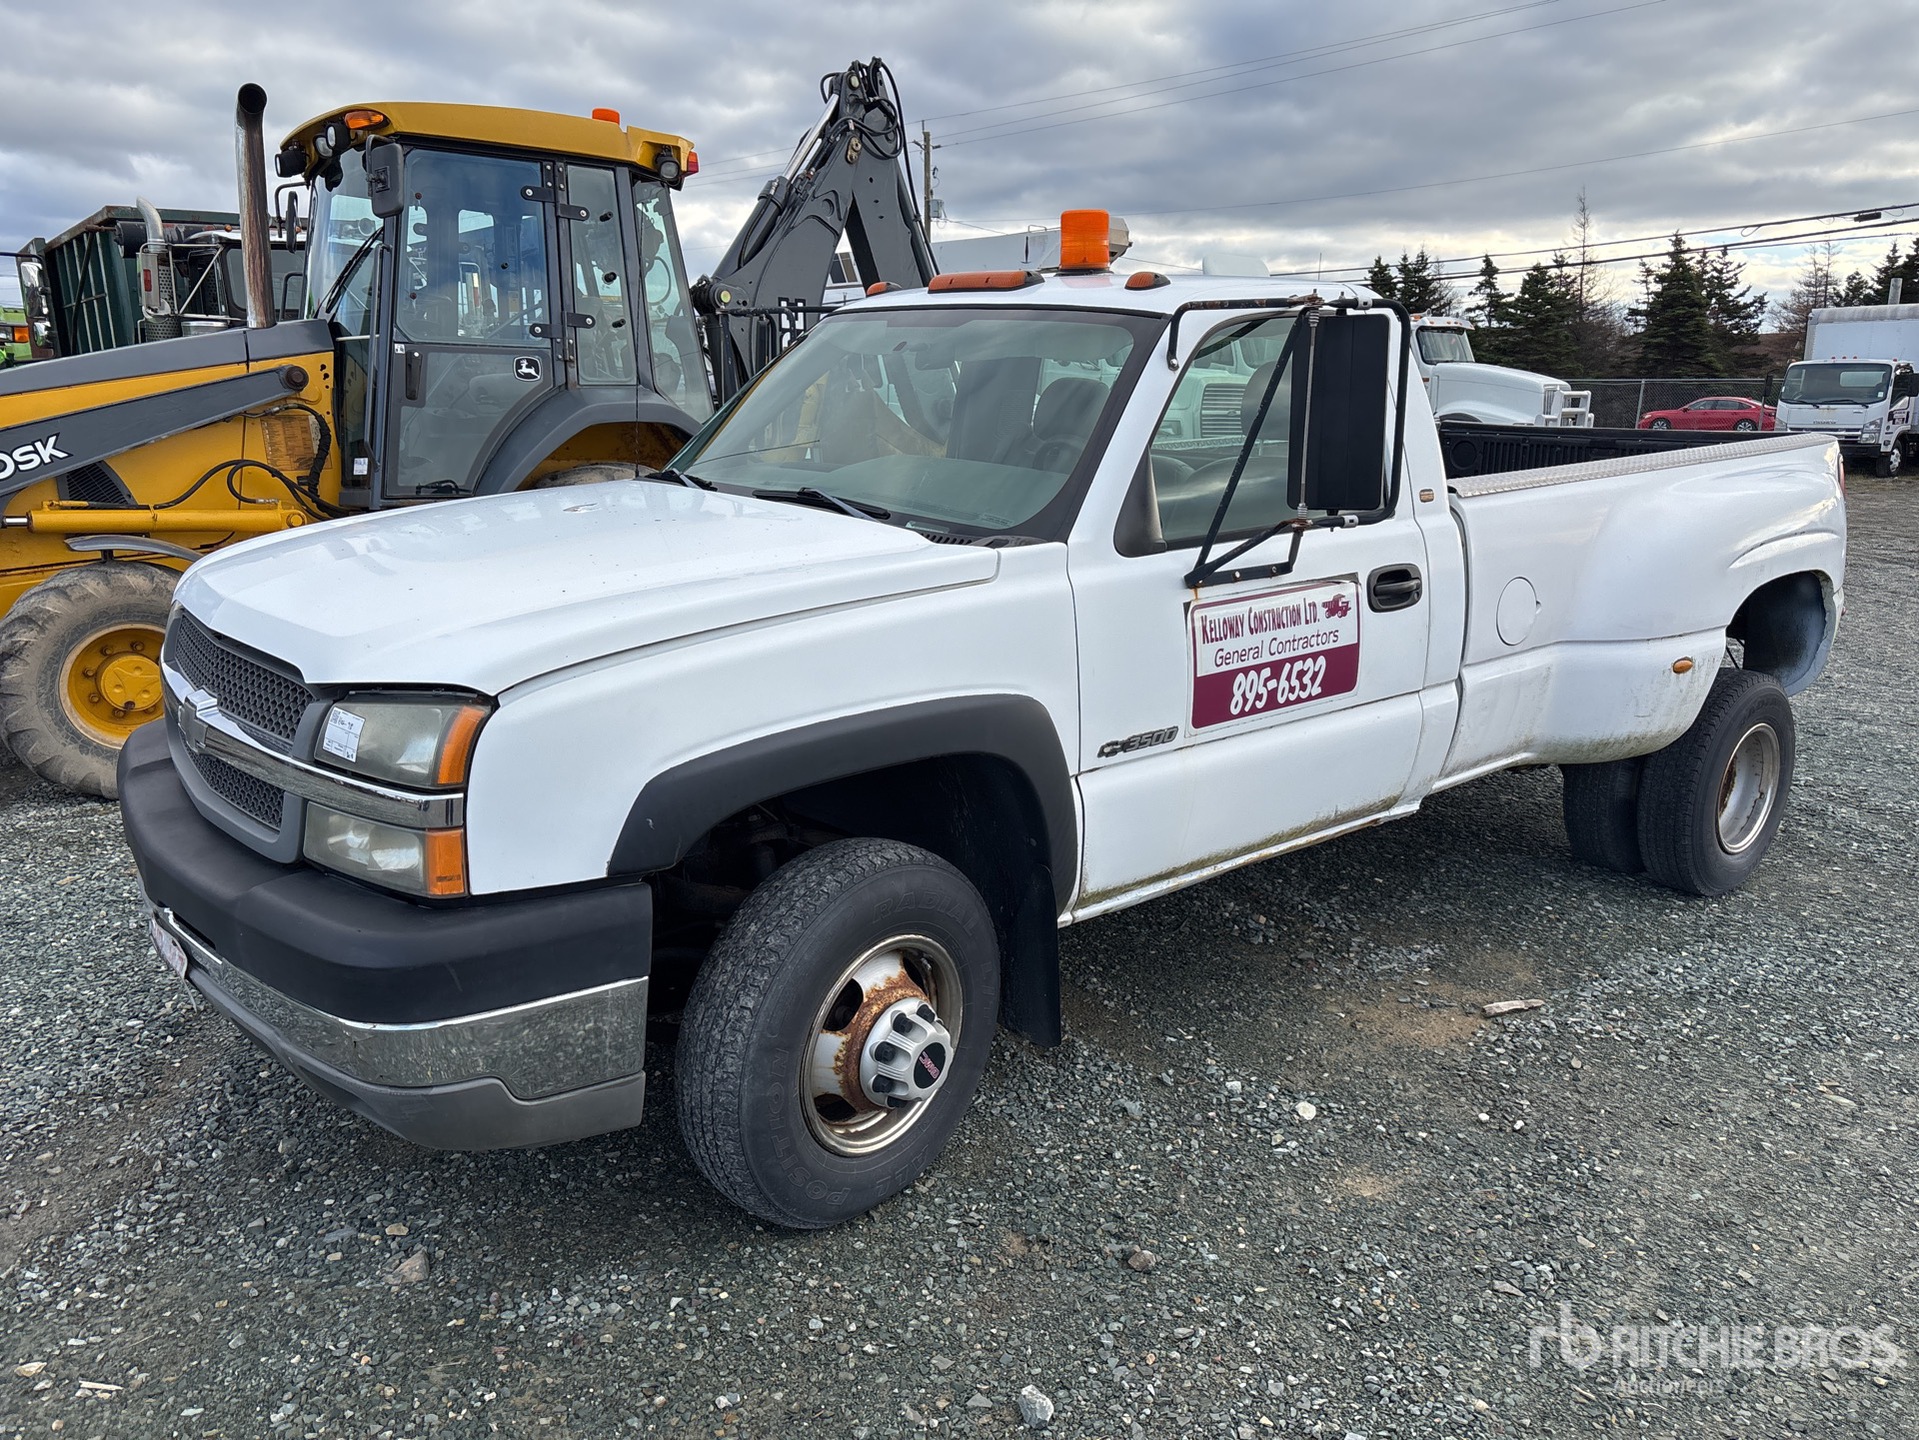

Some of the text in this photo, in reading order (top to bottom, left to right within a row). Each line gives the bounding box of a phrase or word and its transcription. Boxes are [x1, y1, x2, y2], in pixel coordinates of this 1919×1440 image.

[1200, 613, 1245, 645] KELLOWAY
[1247, 602, 1302, 636] CONSTRUCTION
[1214, 628, 1339, 668] General Contractors
[1229, 655, 1327, 716] 895-6532
[767, 1047, 851, 1206] POSITION
[872, 890, 980, 938] RADIAL
